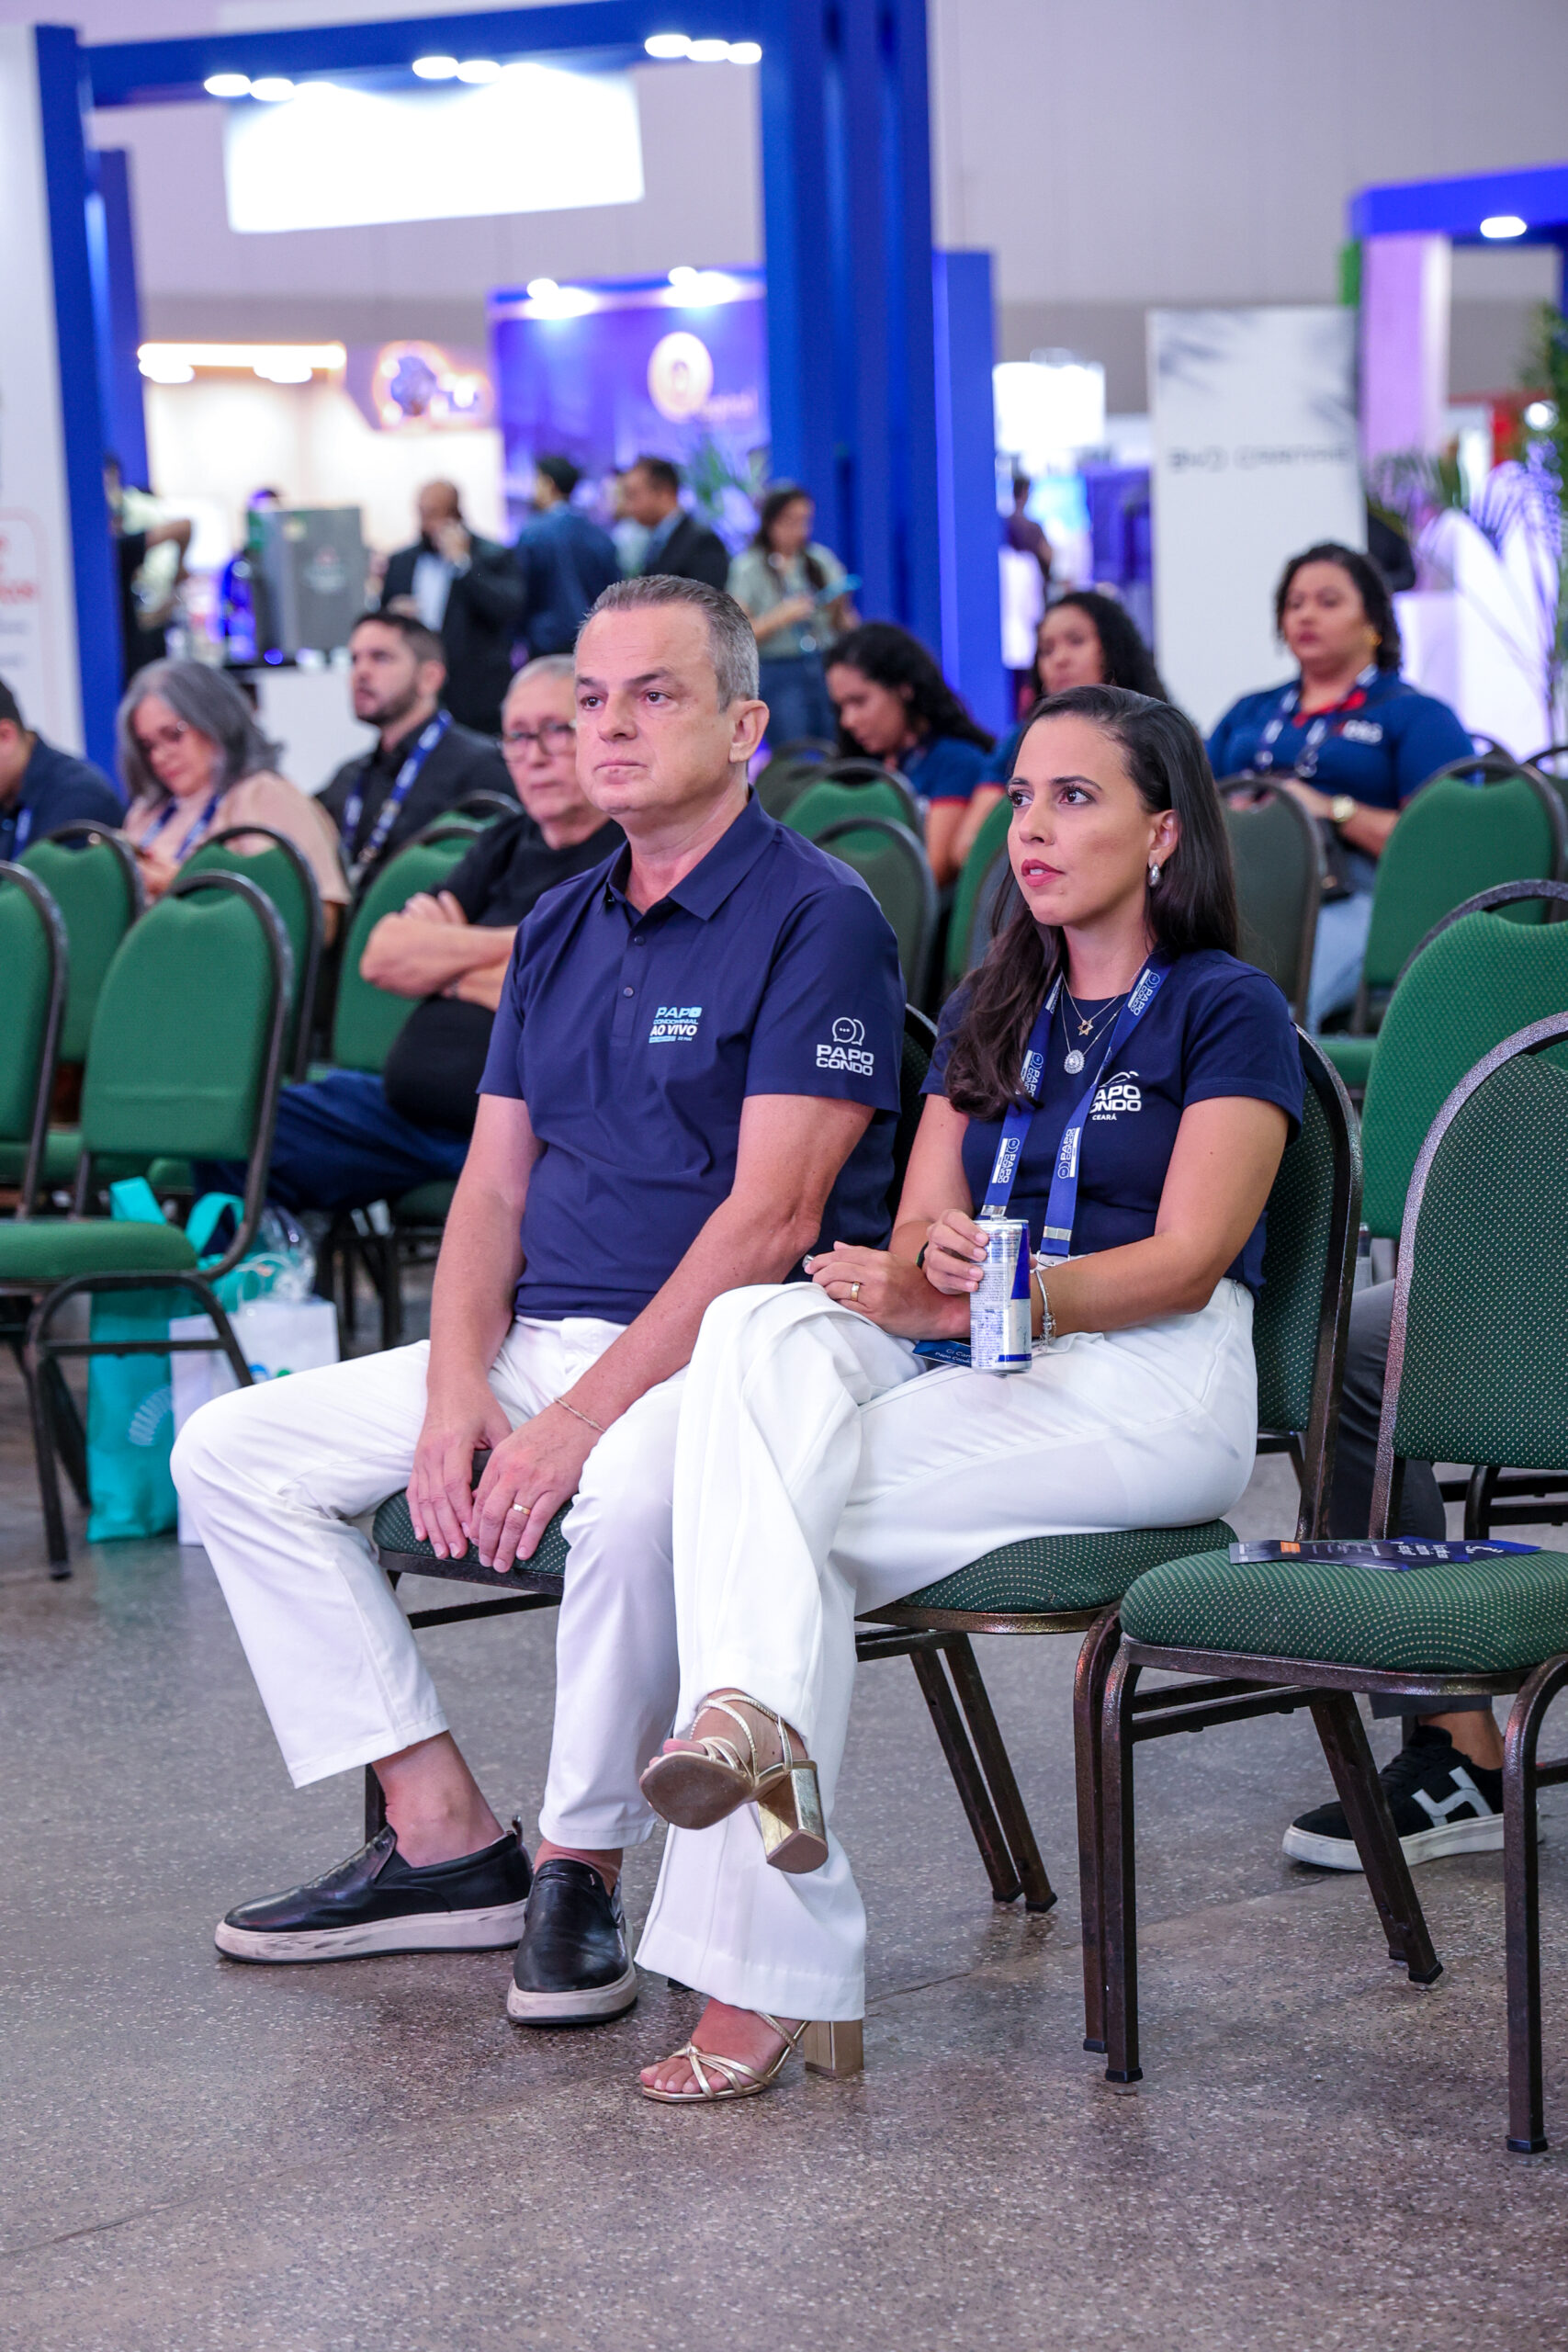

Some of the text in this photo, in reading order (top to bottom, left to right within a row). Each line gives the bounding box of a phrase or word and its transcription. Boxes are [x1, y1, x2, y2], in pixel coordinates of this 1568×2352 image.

[1130, 985, 1147, 1012] CONDO
[1133, 988, 1154, 1016] PAPO
[655, 1006, 703, 1018] PAPO
[649, 1024, 698, 1036] AO VIVO
[817, 1044, 874, 1066] PAPO
[816, 1057, 874, 1076] CONDO
[1093, 1084, 1141, 1102] APO
[1089, 1099, 1142, 1114] ONDO
[1092, 1113, 1117, 1121] CEARÁ
[1061, 1129, 1073, 1161] PAPO
[1066, 1127, 1076, 1160] CONDO
[997, 1154, 1010, 1184] CONDO
[1002, 1153, 1017, 1183] PAPO
